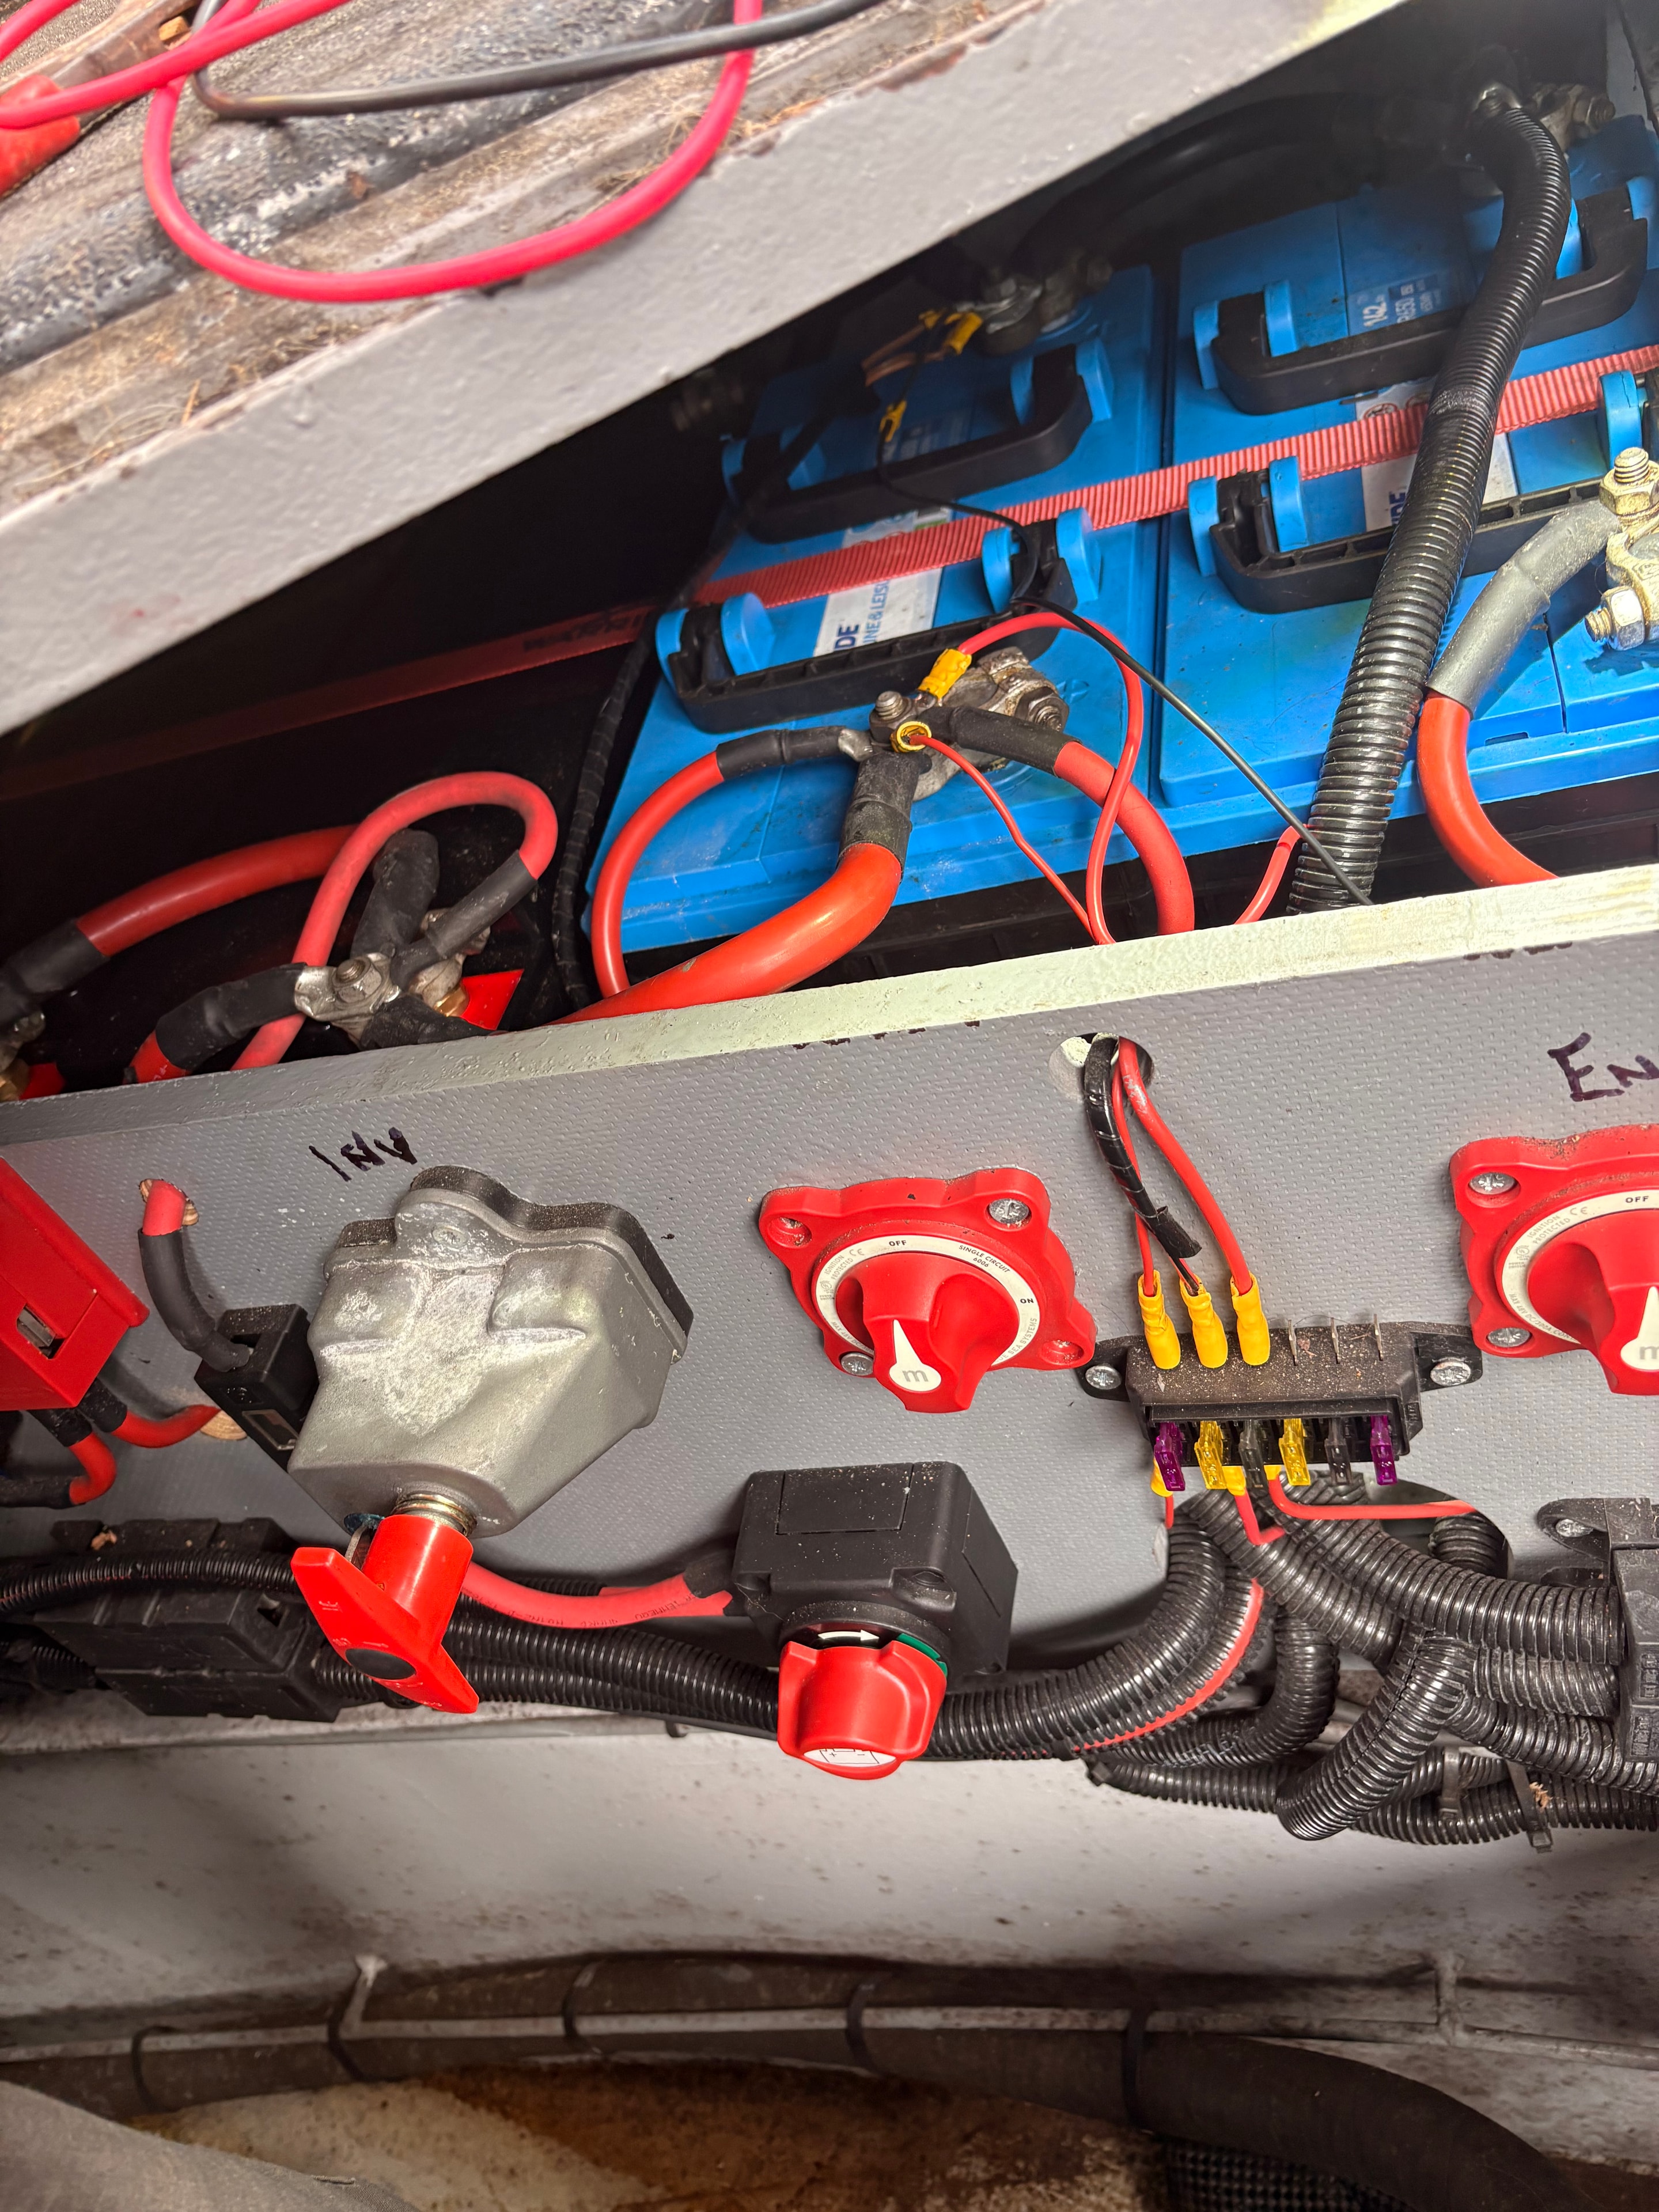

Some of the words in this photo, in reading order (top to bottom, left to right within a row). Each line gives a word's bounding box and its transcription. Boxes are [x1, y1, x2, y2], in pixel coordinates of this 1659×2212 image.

[868, 611, 883, 620] &
[1527, 1215, 1560, 1238] IGNITION
[1533, 1218, 1570, 1244] PROTECTED
[824, 1255, 844, 1275] IGNITION
[831, 1258, 853, 1279] PROTECTED
[959, 1245, 984, 1257] SINGLE
[985, 1256, 1010, 1272] CIRCUIT
[973, 1257, 989, 1267] 6006
[1008, 1344, 1022, 1354] SEA
[1020, 1318, 1037, 1344] SYSTEMS
